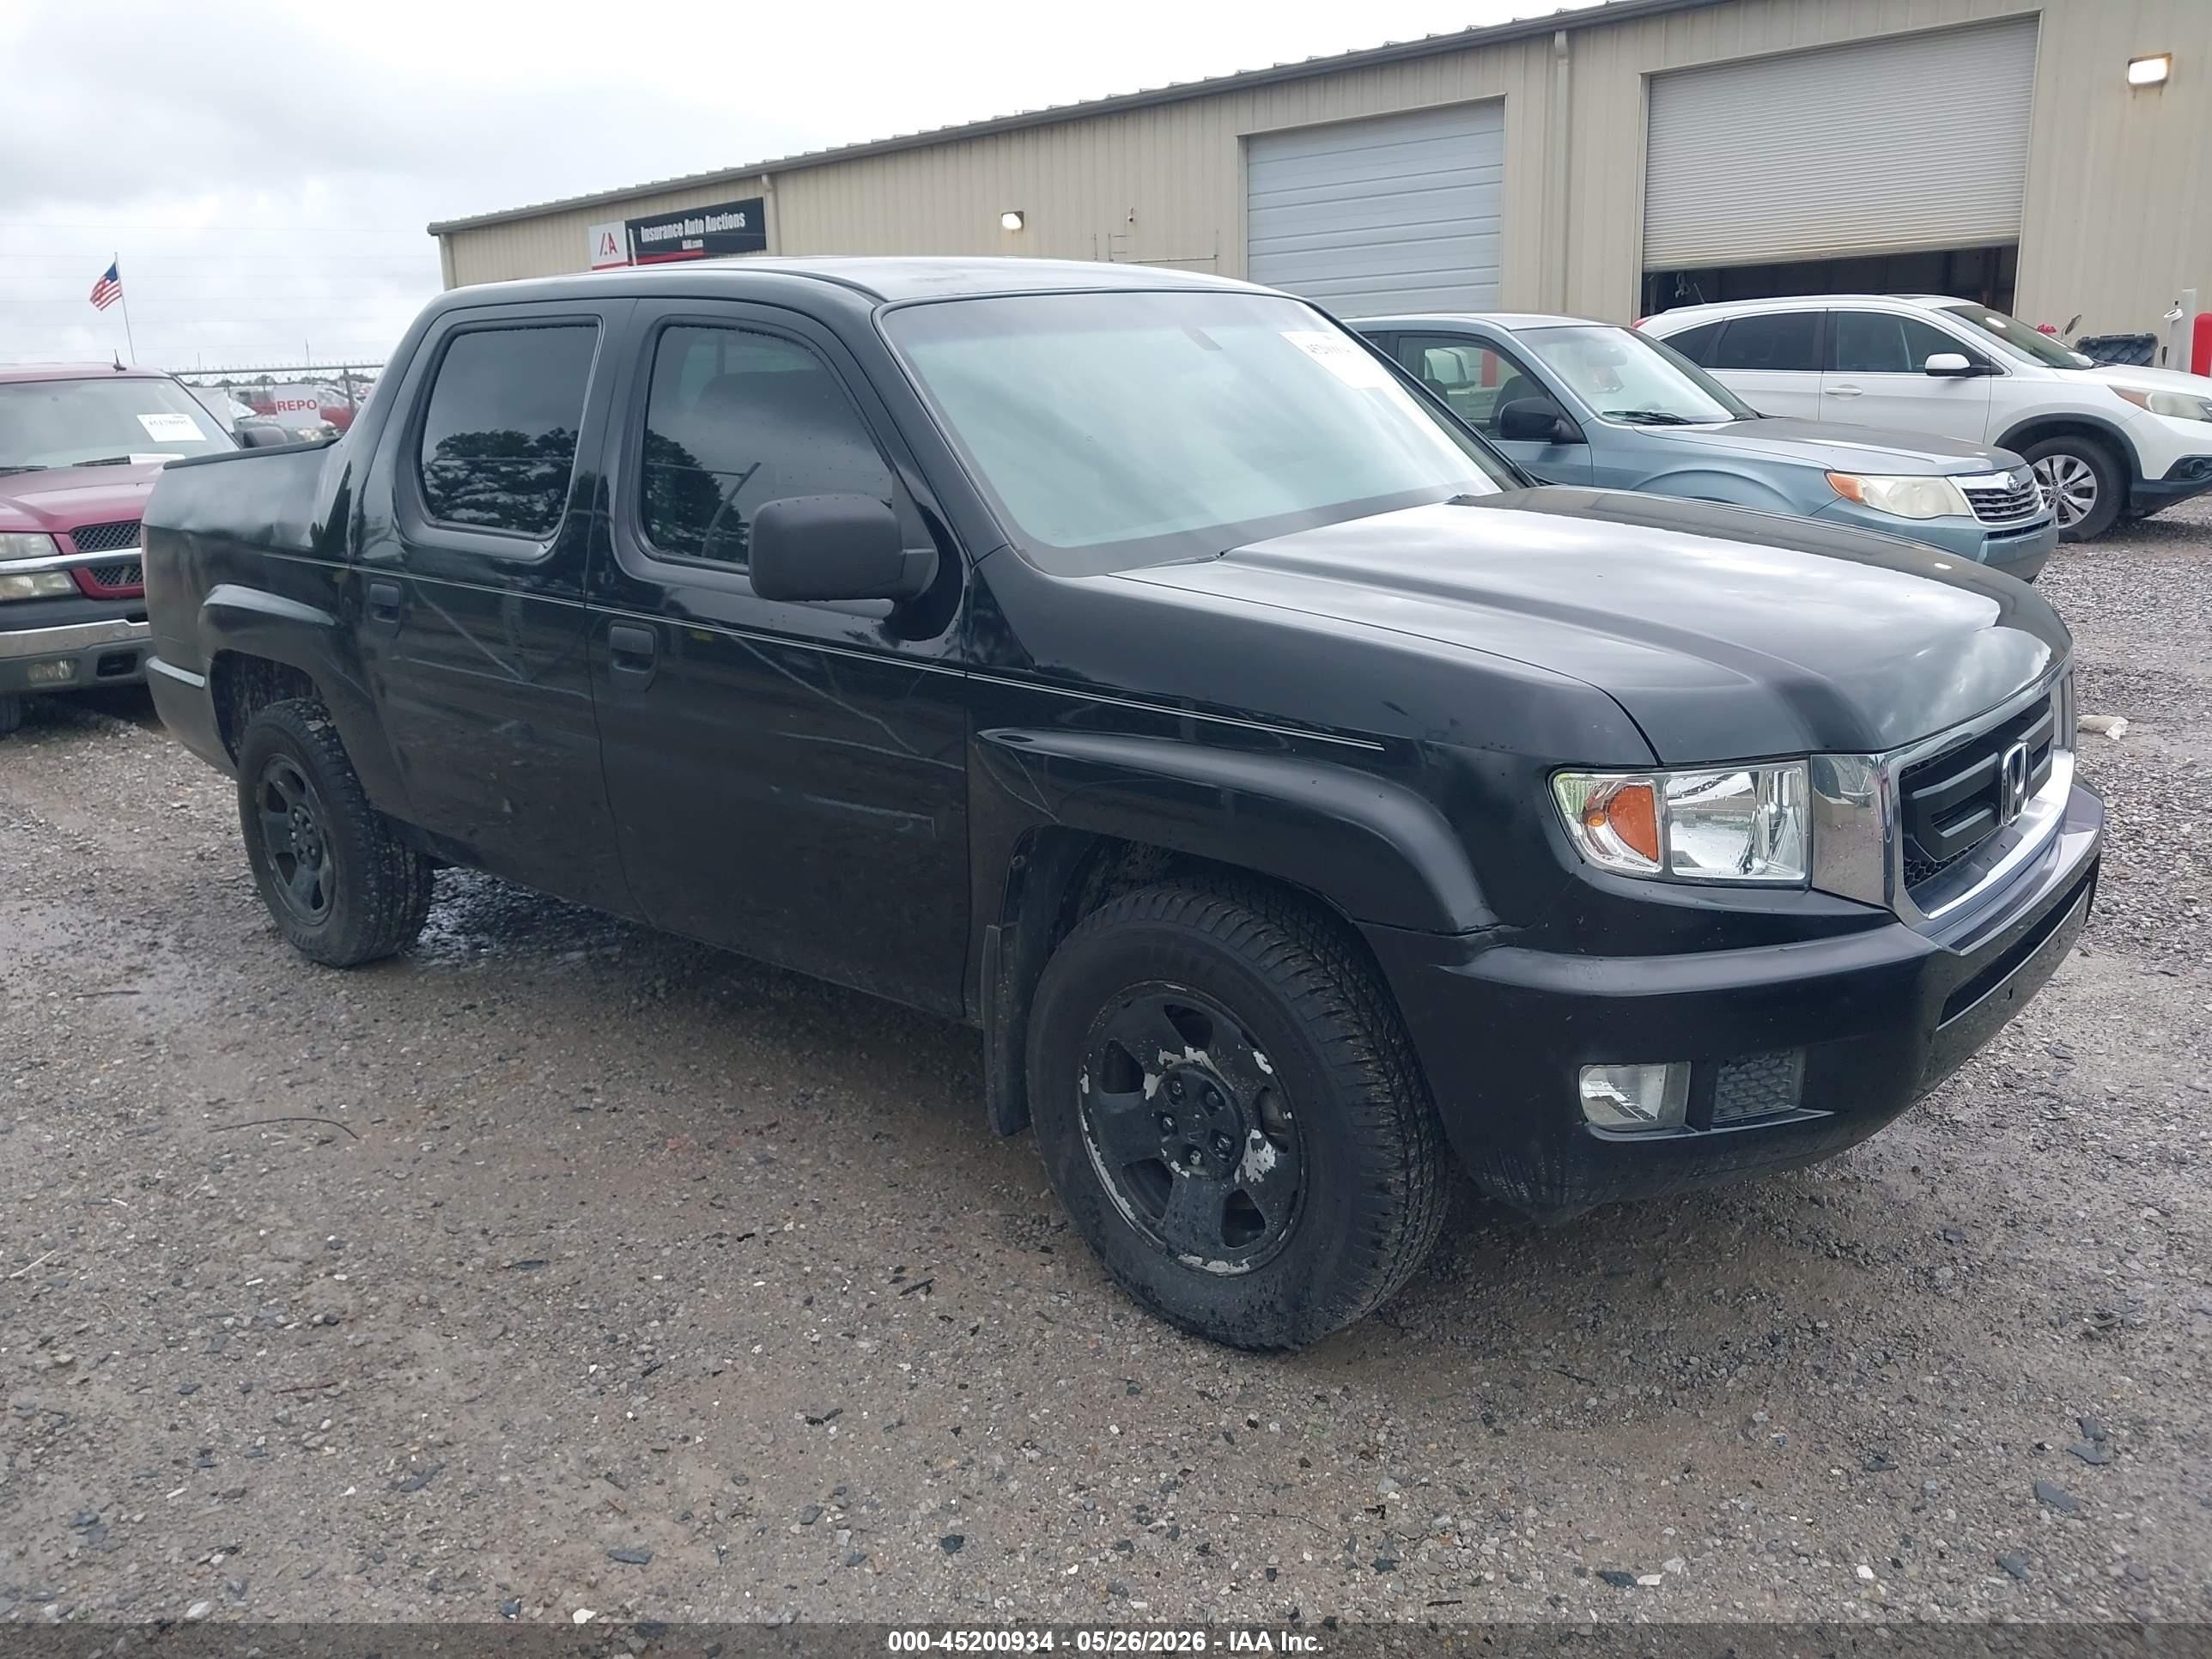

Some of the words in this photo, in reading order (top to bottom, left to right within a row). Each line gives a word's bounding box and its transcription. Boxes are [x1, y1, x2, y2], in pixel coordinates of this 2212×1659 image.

[641, 222, 684, 243] Insurance
[684, 218, 705, 236] Auto
[705, 212, 745, 233] Auctions
[276, 398, 318, 412] REPO
